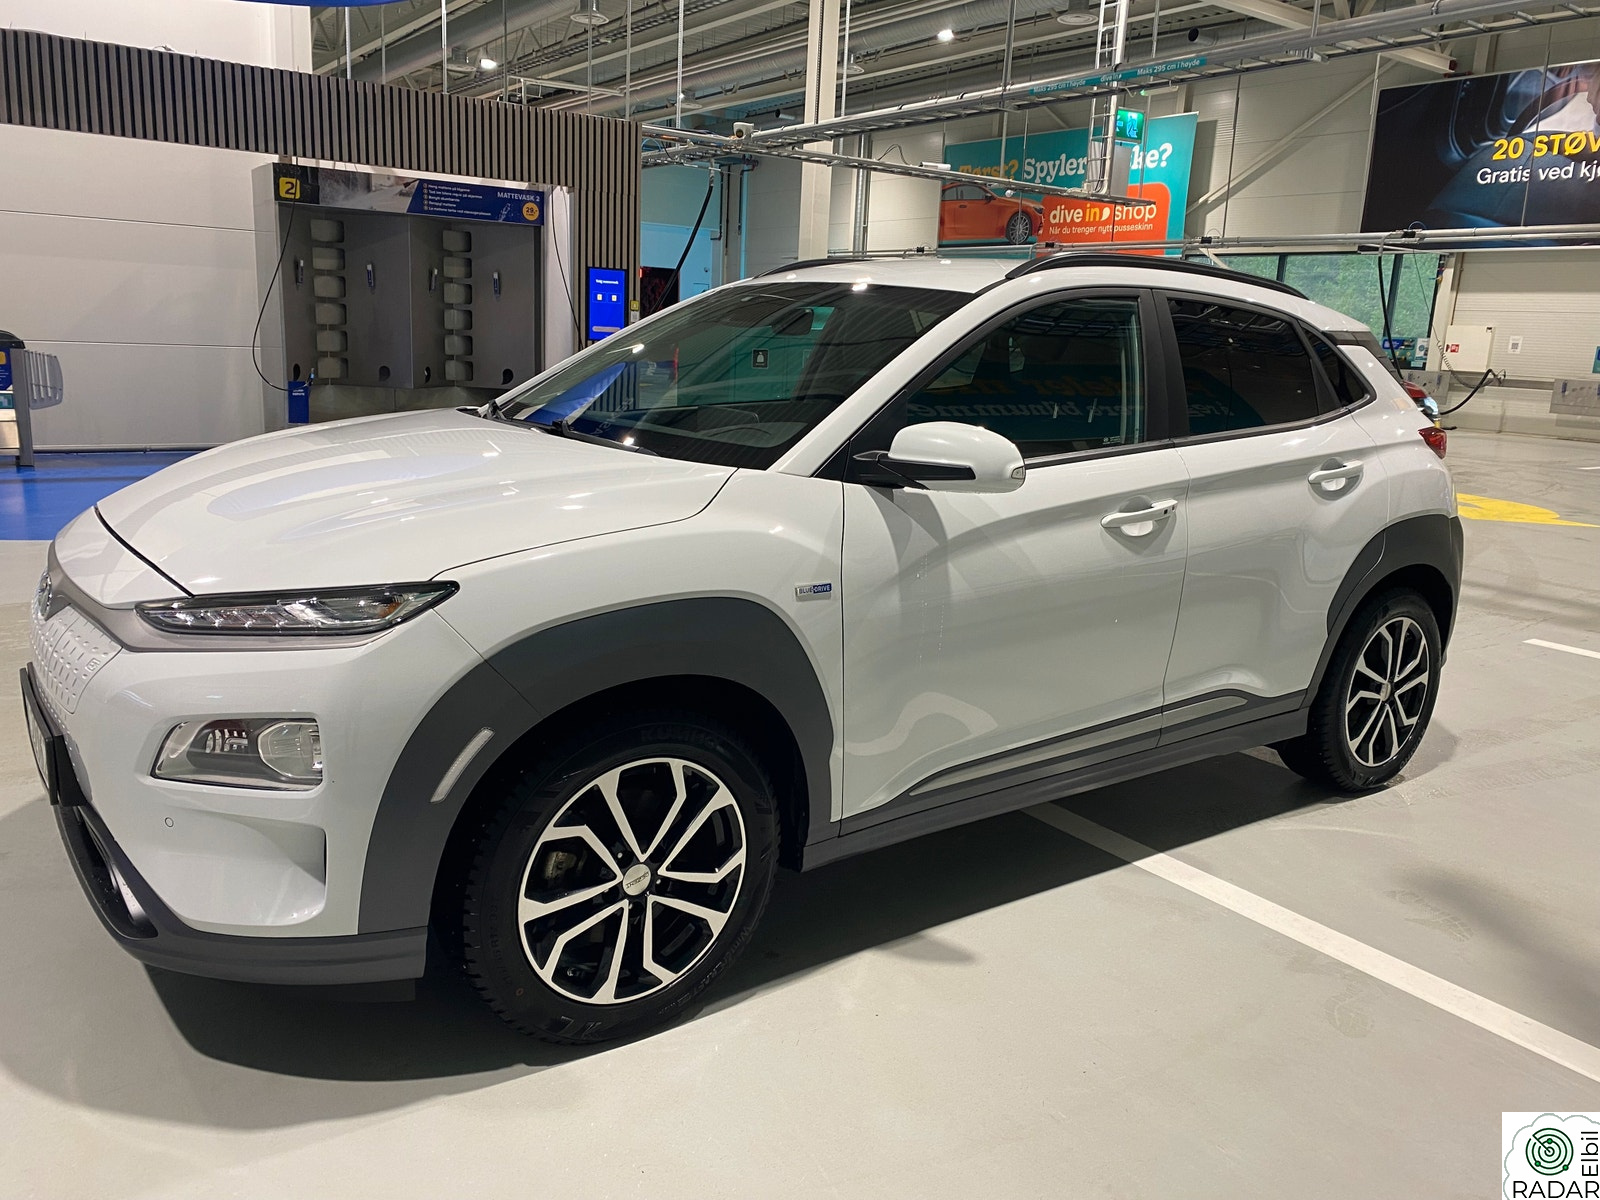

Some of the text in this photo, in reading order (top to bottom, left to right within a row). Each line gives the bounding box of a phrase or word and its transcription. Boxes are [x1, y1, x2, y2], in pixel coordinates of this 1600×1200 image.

[1181, 59, 1200, 68] høyde
[1492, 137, 1525, 160] 20
[1476, 166, 1531, 185] Gratis
[1538, 162, 1575, 180] ved
[285, 181, 296, 195] 2
[497, 191, 534, 202] MATTEVASK
[1049, 205, 1083, 224] dive
[1114, 204, 1157, 221] shop
[1049, 223, 1153, 235] Når du trenger nytt pusseskinn
[799, 586, 813, 594] BLUE
